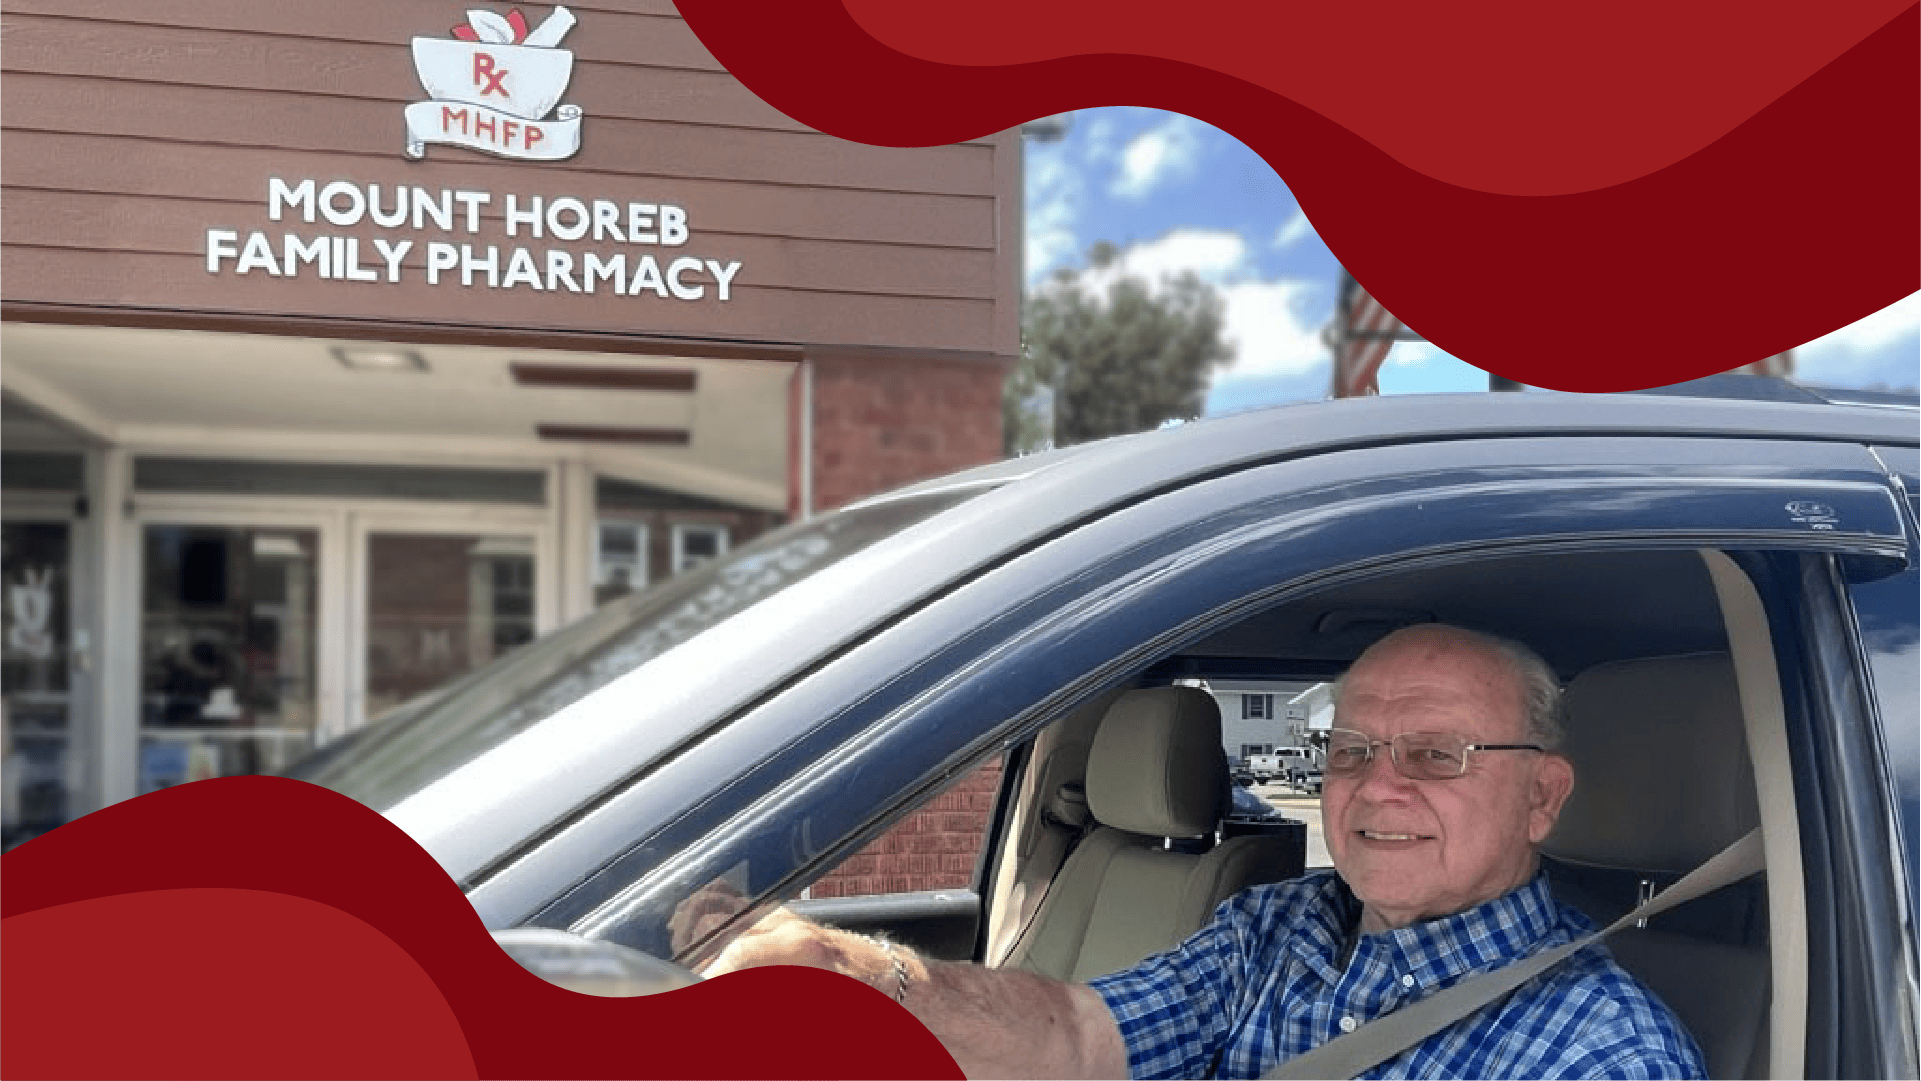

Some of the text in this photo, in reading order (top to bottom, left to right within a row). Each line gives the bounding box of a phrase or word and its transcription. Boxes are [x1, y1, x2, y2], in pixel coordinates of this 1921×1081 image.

[442, 106, 545, 150] MHFP
[268, 178, 690, 246] MOUNT HOREB
[206, 229, 742, 301] FAMILY PHARMACY
